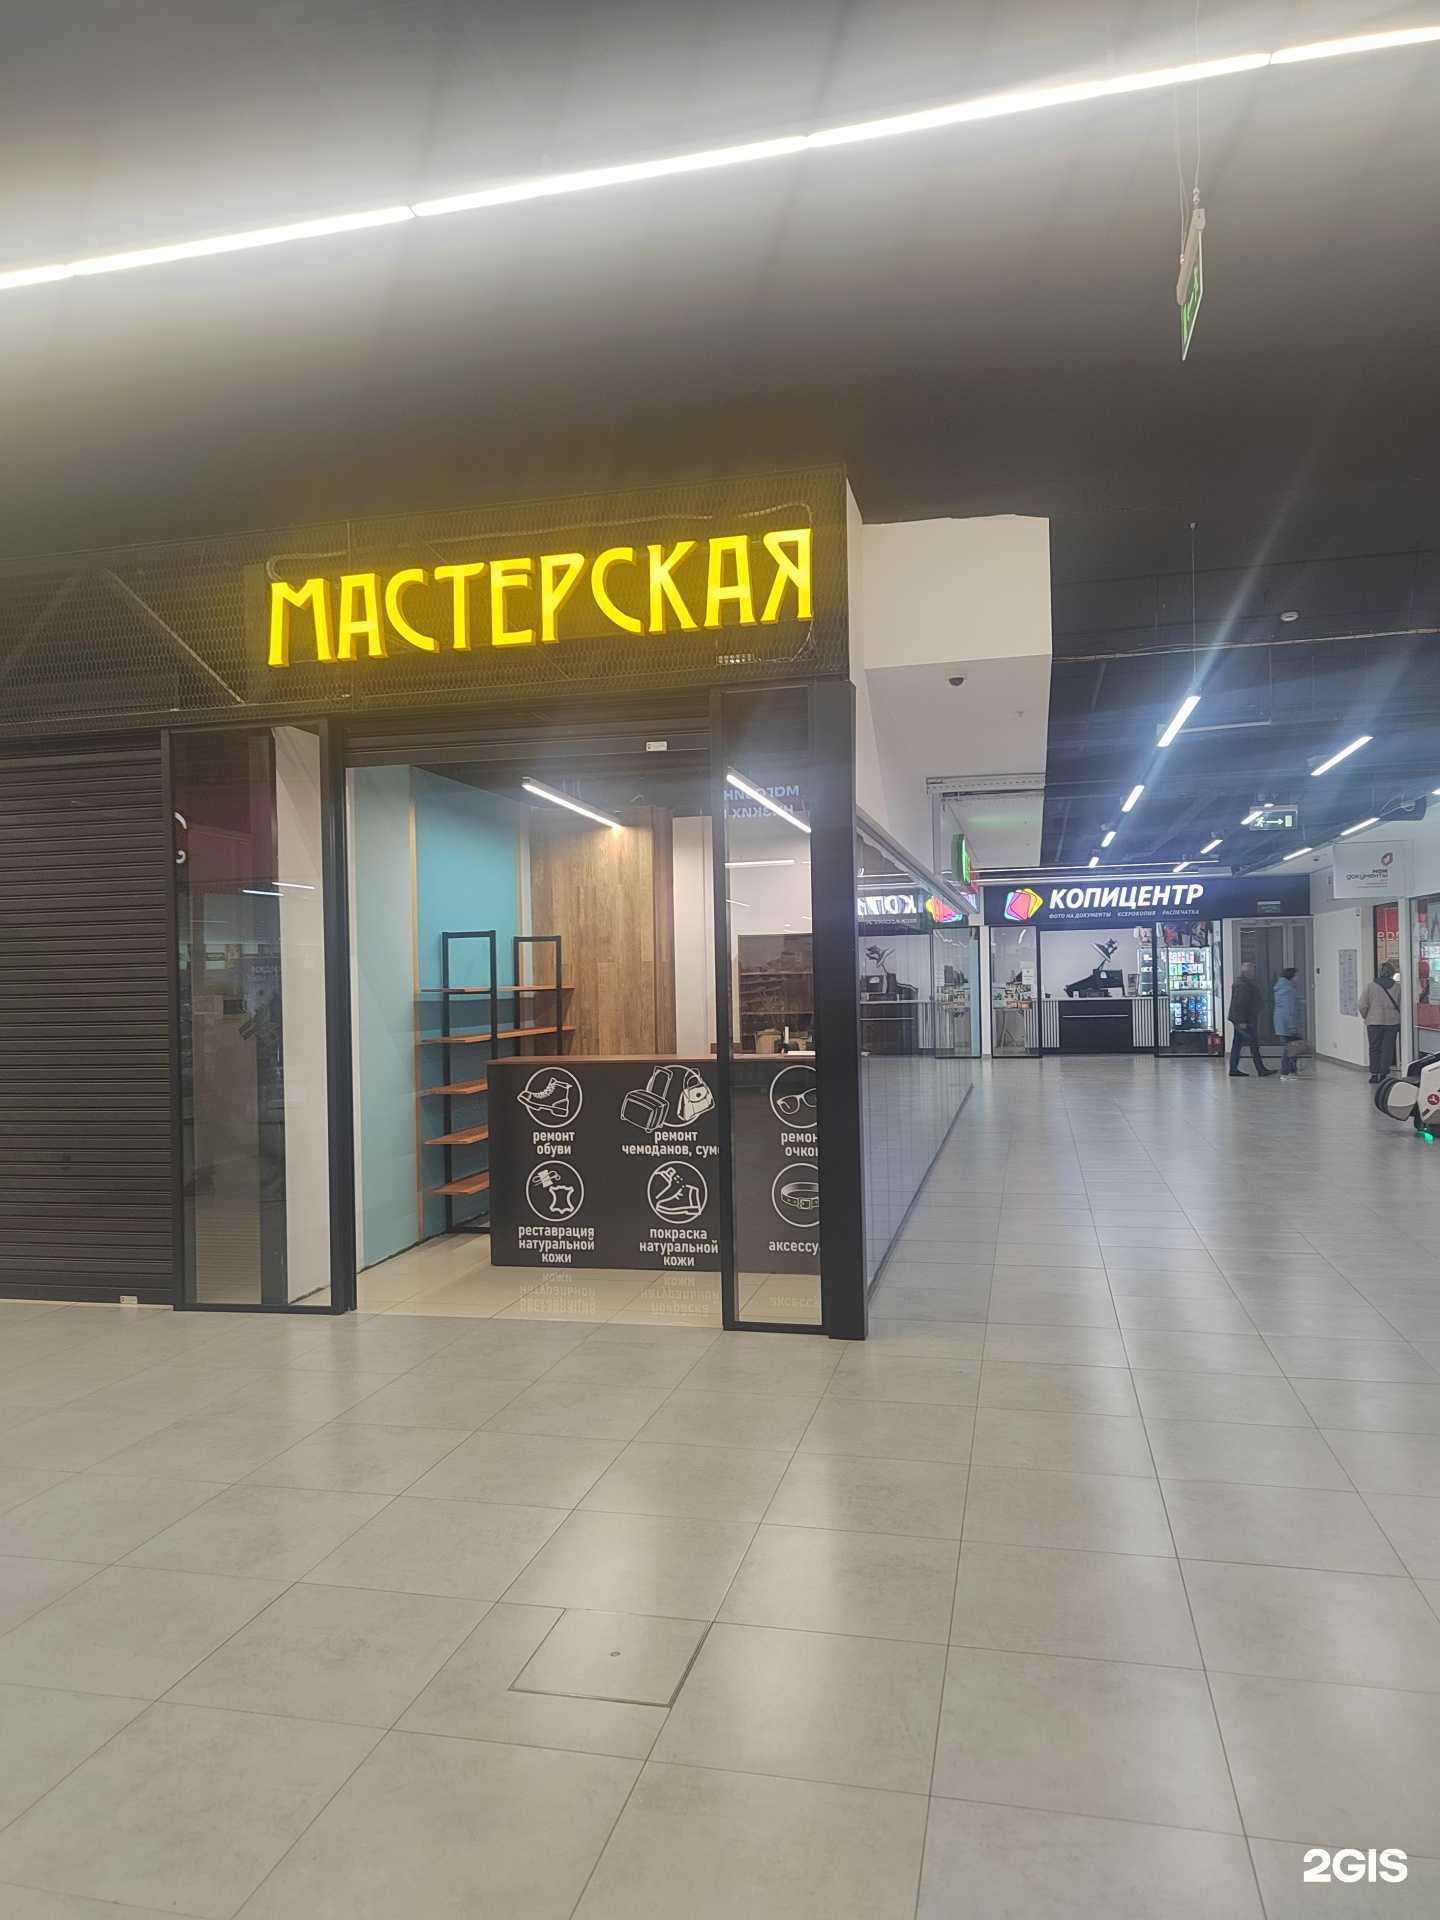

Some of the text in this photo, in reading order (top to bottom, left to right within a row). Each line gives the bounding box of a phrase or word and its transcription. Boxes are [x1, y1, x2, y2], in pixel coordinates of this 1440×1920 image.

[268, 528, 814, 667] МАСТЕРСКАЯ
[1049, 884, 1204, 910] КОПИЦЕНТР
[533, 1131, 575, 1144] ремонт
[654, 1131, 698, 1144] ремонт
[536, 1142, 572, 1157] обуви
[621, 1144, 720, 1158] чемоданов, сум
[518, 1226, 595, 1240] реставрация
[650, 1228, 708, 1242] покраска
[518, 1236, 595, 1252] натуральной
[640, 1239, 719, 1255] натуральной
[541, 1253, 572, 1263] кожи
[663, 1256, 695, 1267] кожи
